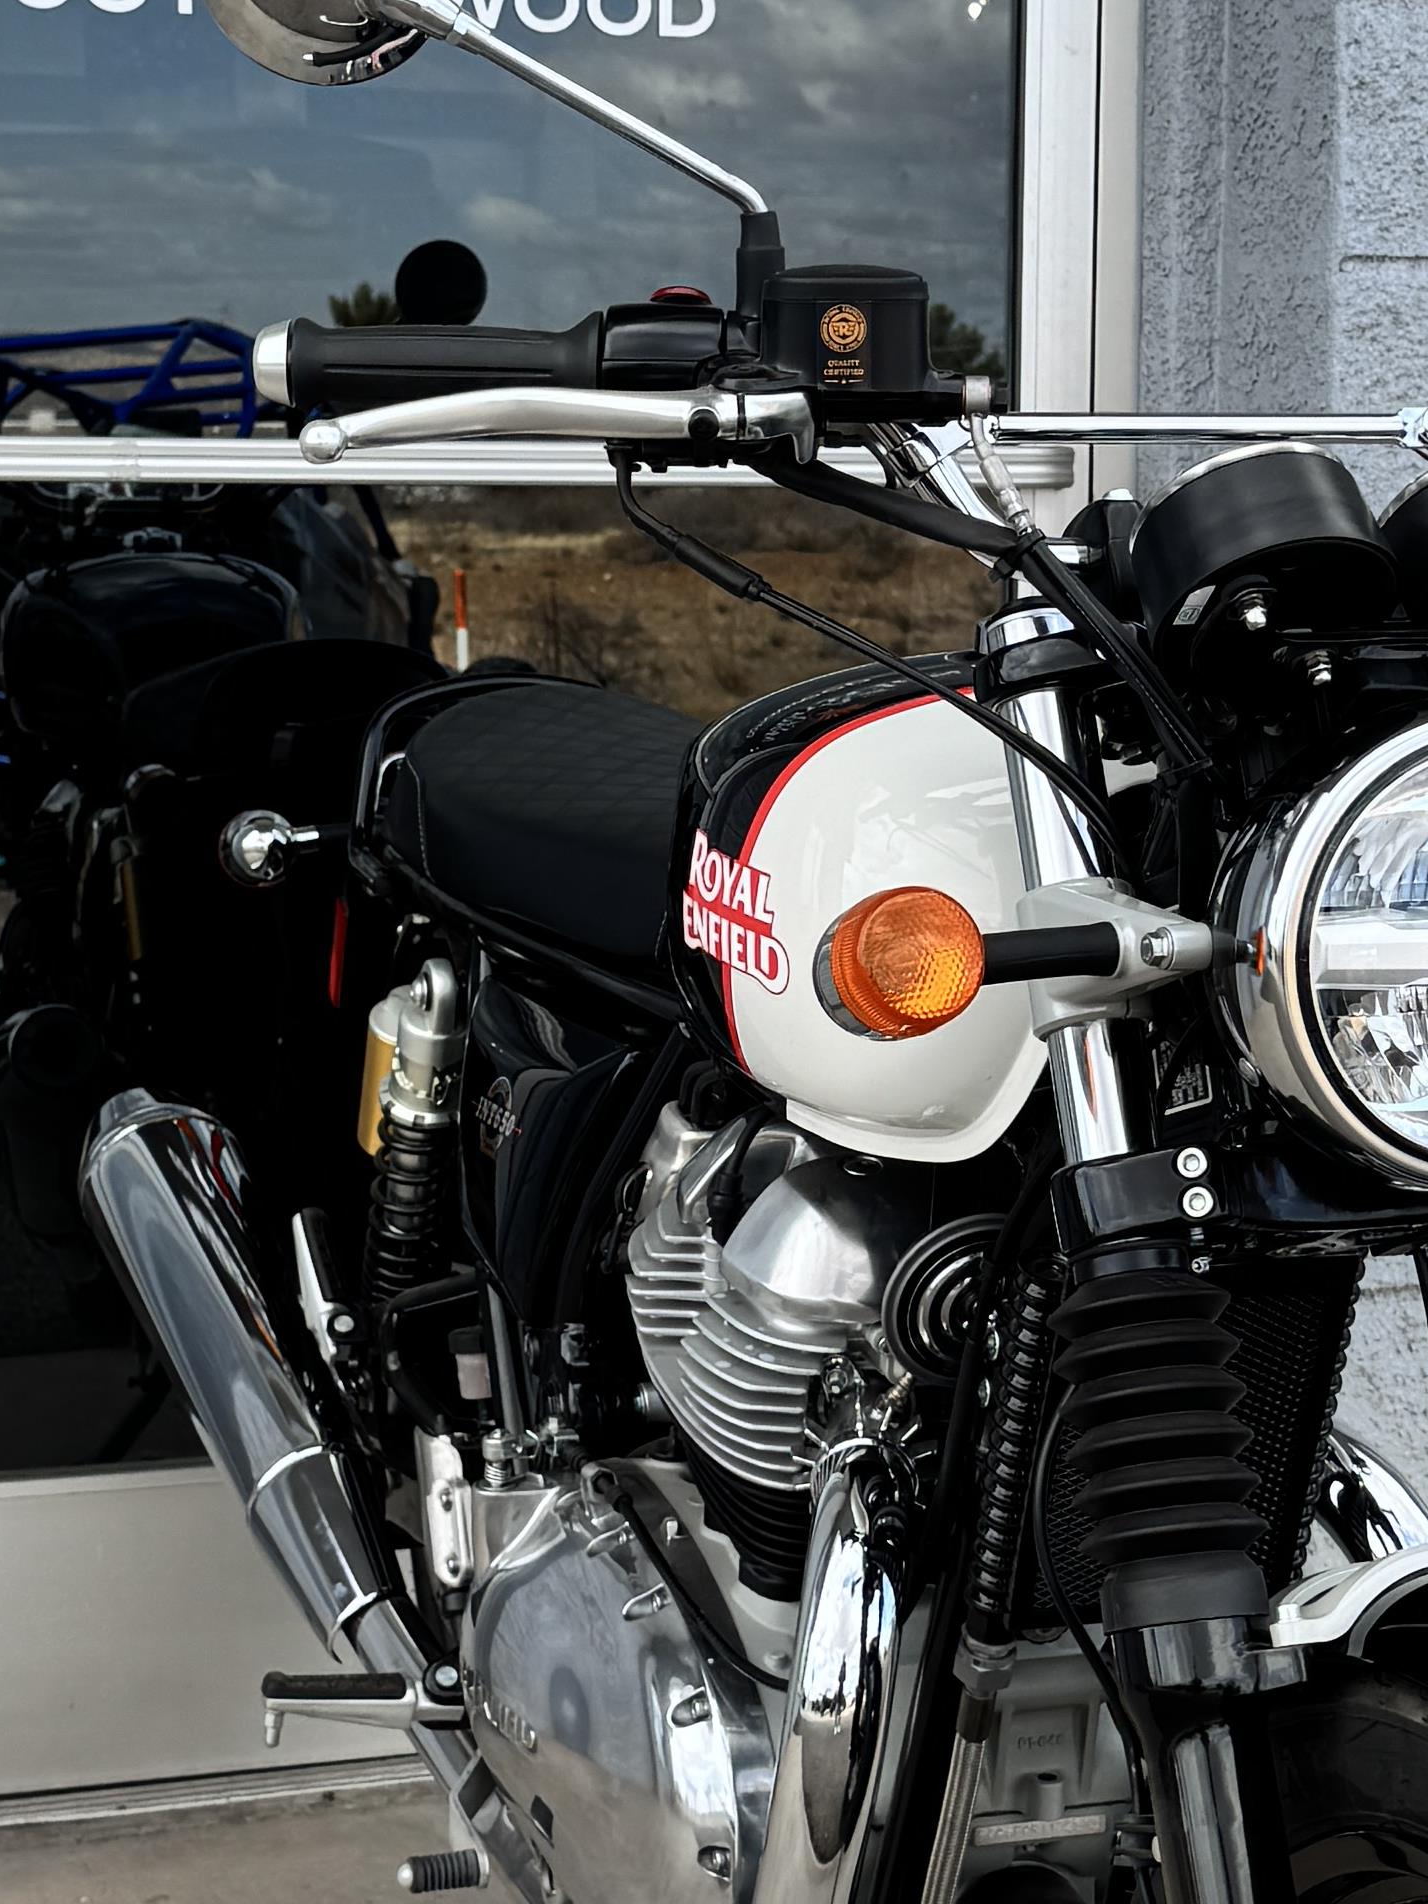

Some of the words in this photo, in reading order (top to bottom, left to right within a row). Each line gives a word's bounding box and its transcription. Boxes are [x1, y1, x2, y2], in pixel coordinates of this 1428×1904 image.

[823, 368, 865, 376] CERTIFIED
[827, 359, 860, 367] QUALITY
[688, 828, 775, 925] ROYAL
[682, 890, 790, 995] ENFIELD
